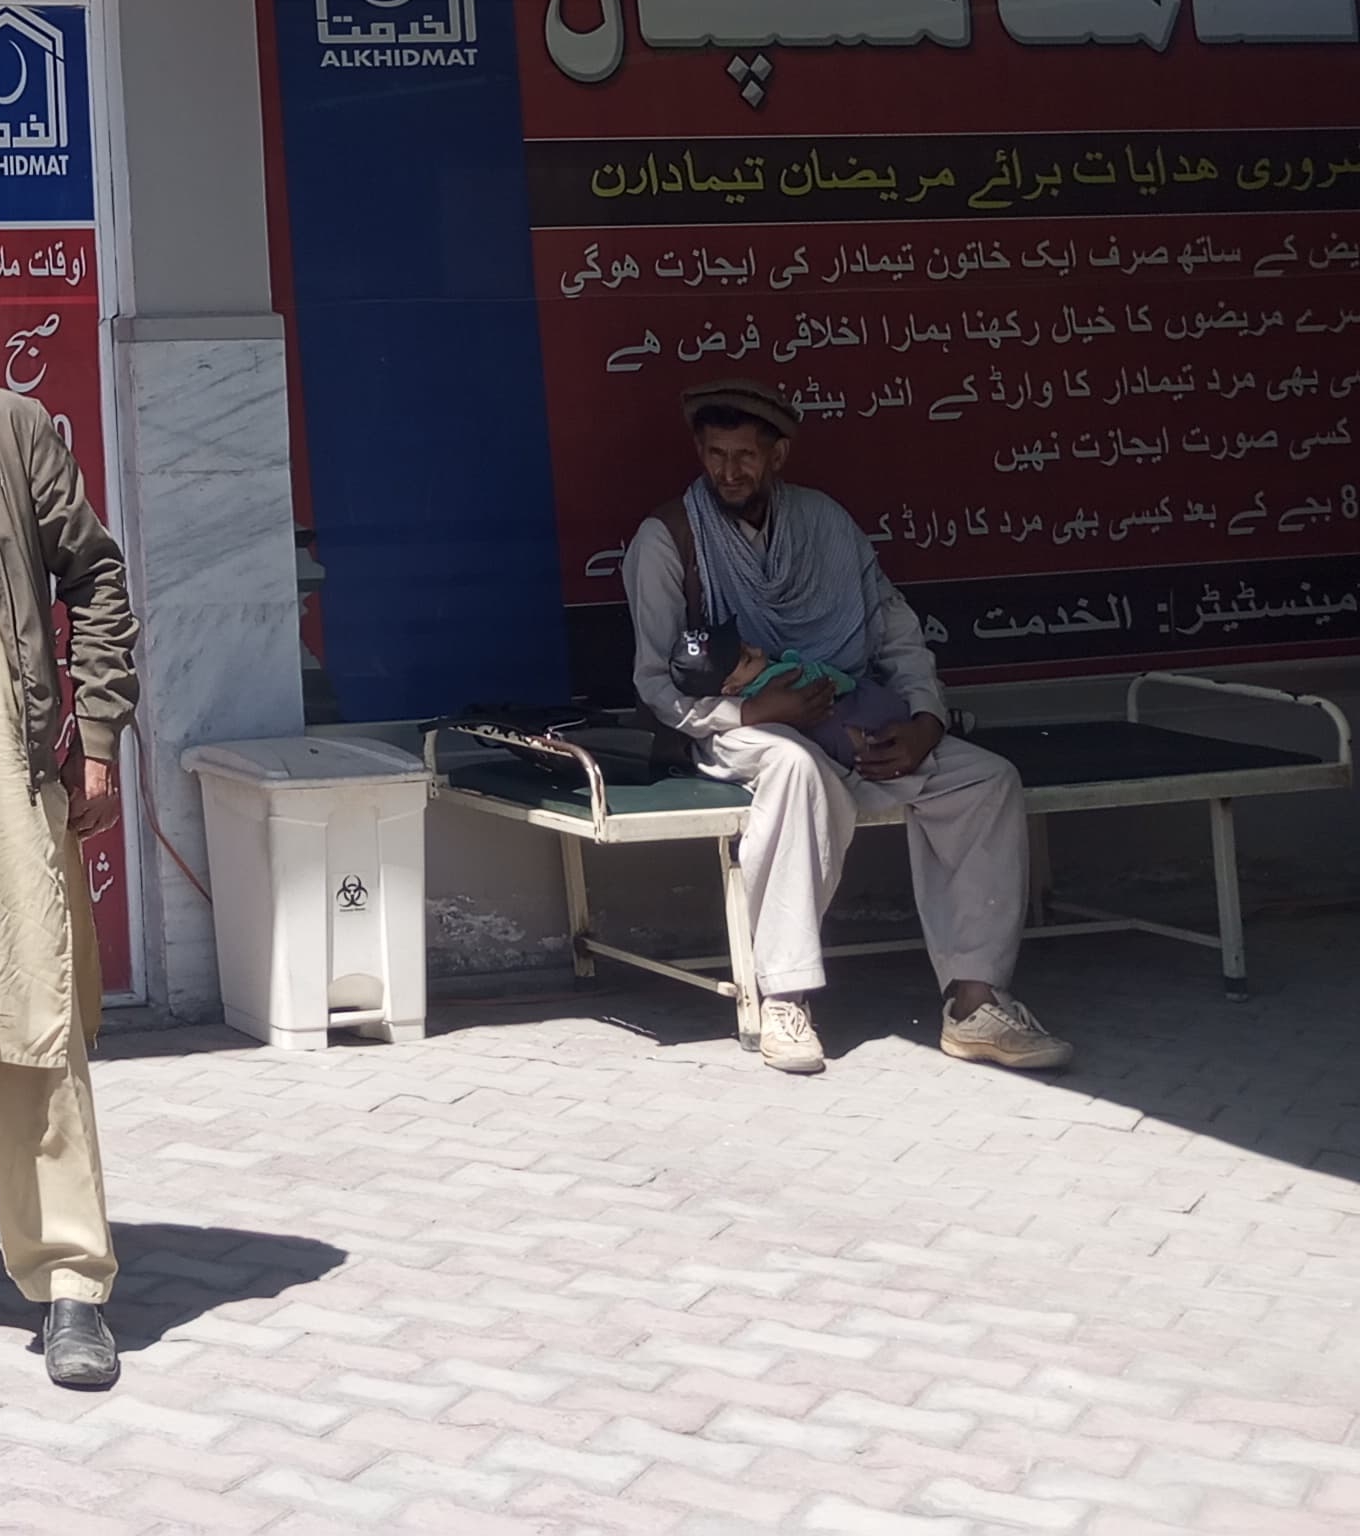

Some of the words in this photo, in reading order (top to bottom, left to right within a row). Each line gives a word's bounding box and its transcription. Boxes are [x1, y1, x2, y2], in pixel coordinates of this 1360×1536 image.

[320, 48, 478, 68] ALKHIDMAT
[967, 148, 1063, 209] برائے
[1236, 154, 1360, 192] روری
[28, 241, 87, 287] اوقات
[769, 245, 810, 291] کی
[925, 237, 1012, 281] خاتون
[1020, 239, 1077, 279] ایک
[1088, 235, 1169, 277] صرف
[1177, 234, 1243, 275] ساتھ
[1253, 233, 1301, 278] کے
[677, 313, 761, 362] فرض
[771, 312, 868, 362] اخلاقی
[881, 311, 953, 355] ہمارا
[1052, 304, 1117, 345] خیال
[1125, 304, 1153, 335] کا
[1163, 300, 1285, 340] مریضوں
[4, 312, 61, 393] صبح
[857, 376, 913, 417] اندر
[928, 373, 980, 421] کے
[989, 364, 1054, 410] وارڈ
[1063, 367, 1092, 398] کا
[1206, 367, 1257, 400] مرد
[1266, 365, 1320, 401] بھی
[1182, 424, 1279, 461] صورت
[1288, 416, 1353, 462] کسی
[903, 503, 958, 550] وارڈ
[965, 507, 990, 538] کا
[999, 512, 1043, 544] مرد
[1052, 507, 1100, 545] بھی
[1183, 498, 1218, 530] بعد
[1228, 489, 1268, 535] کے
[1278, 496, 1333, 533] بجے
[973, 592, 1133, 640] الخدمت
[89, 851, 114, 904] شا
